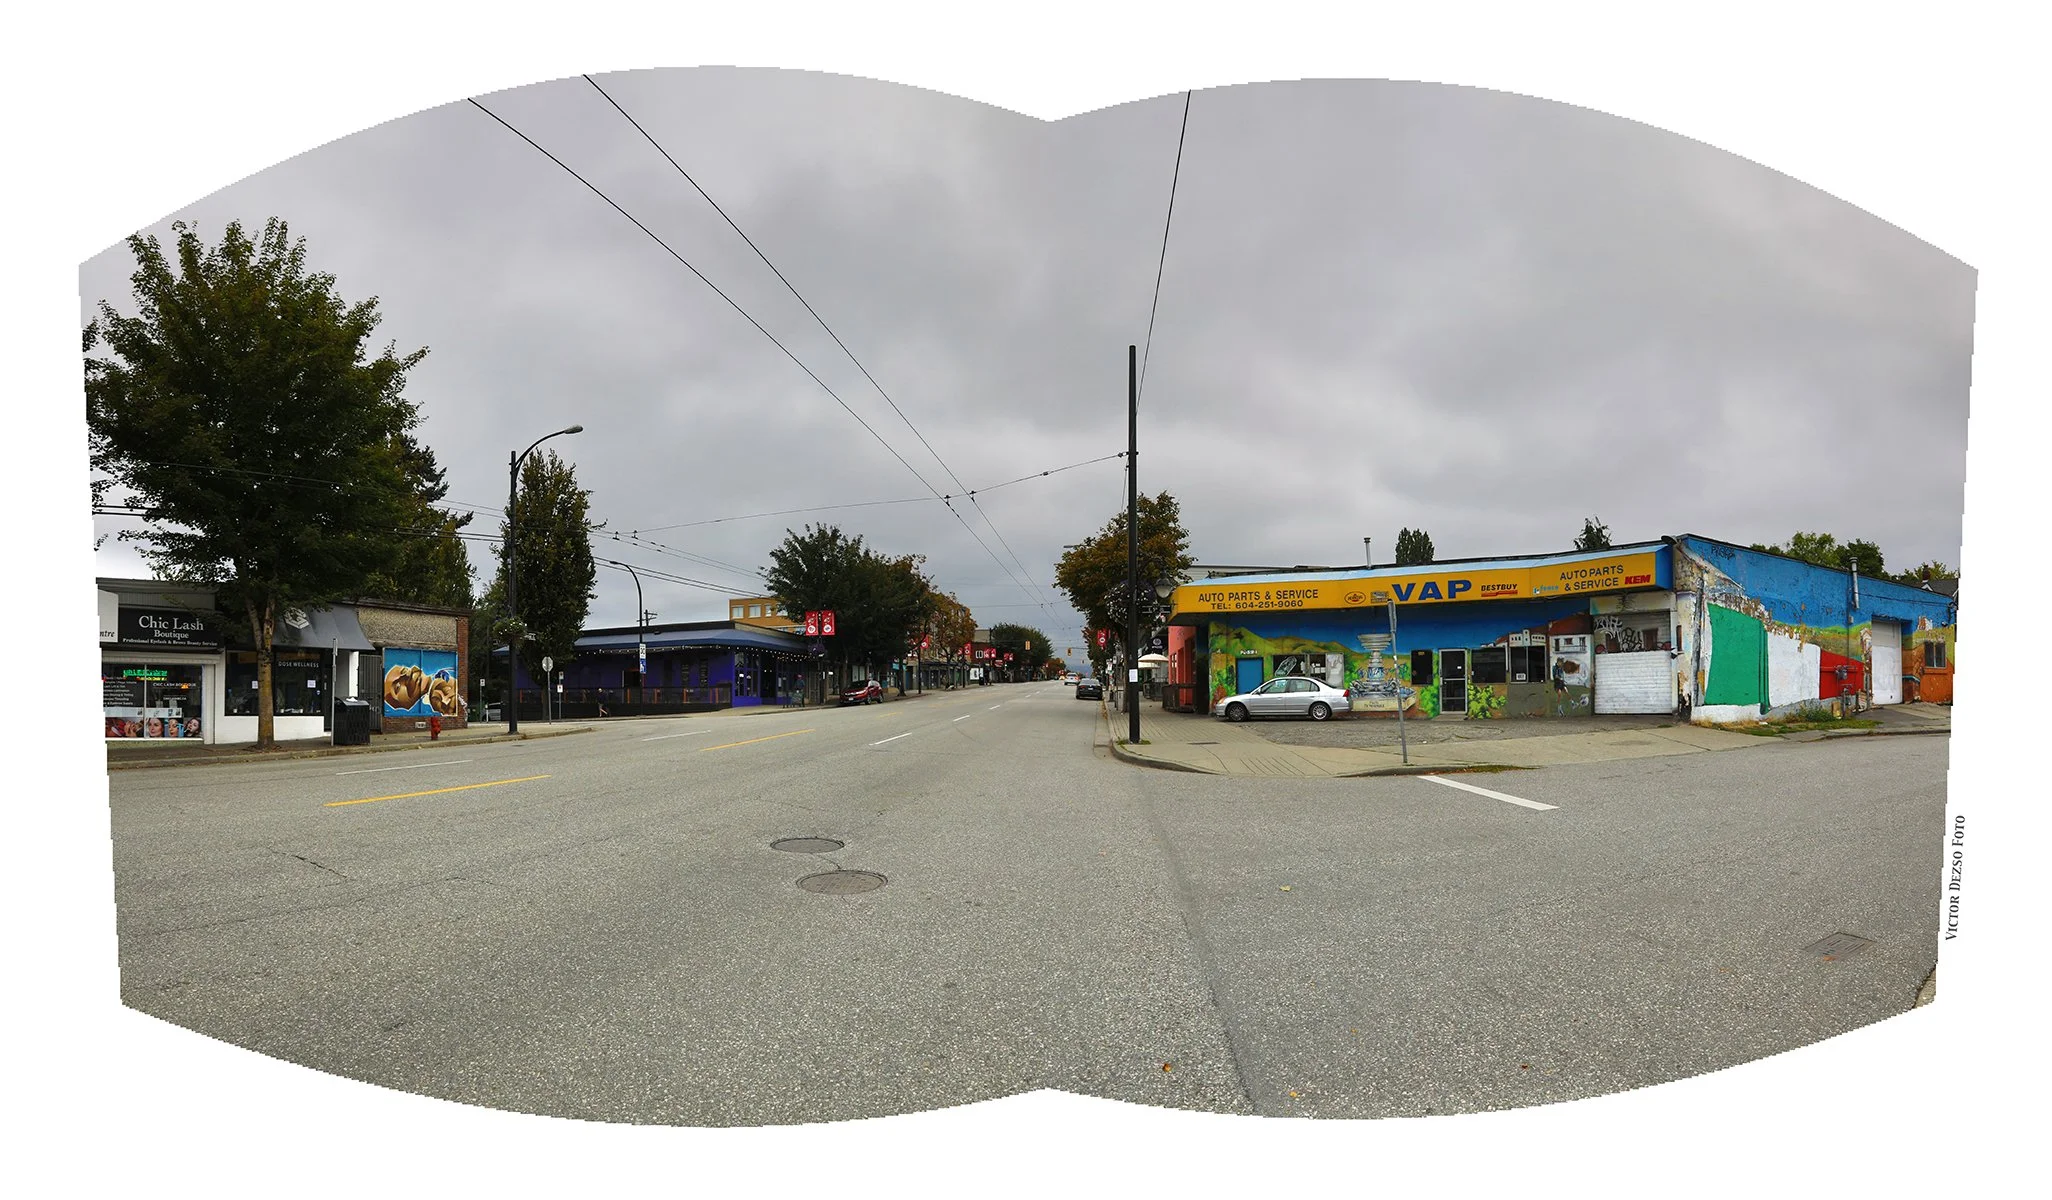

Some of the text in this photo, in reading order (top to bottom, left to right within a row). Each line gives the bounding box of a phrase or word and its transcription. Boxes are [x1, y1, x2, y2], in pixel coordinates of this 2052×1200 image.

[1560, 565, 1624, 581] AUTO PARTS
[1624, 574, 1651, 585] KEM
[1391, 579, 1472, 602] VAP
[1481, 584, 1518, 592] BESTBUY
[1564, 577, 1619, 592] & SERVICE
[1198, 589, 1319, 603] AUTO PARTS & SERVICE
[1211, 600, 1303, 610] TEL: 604-251-9060
[138, 615, 204, 631] Chic Lash
[154, 629, 189, 641] Boutique
[293, 661, 319, 669] WELLNESS
